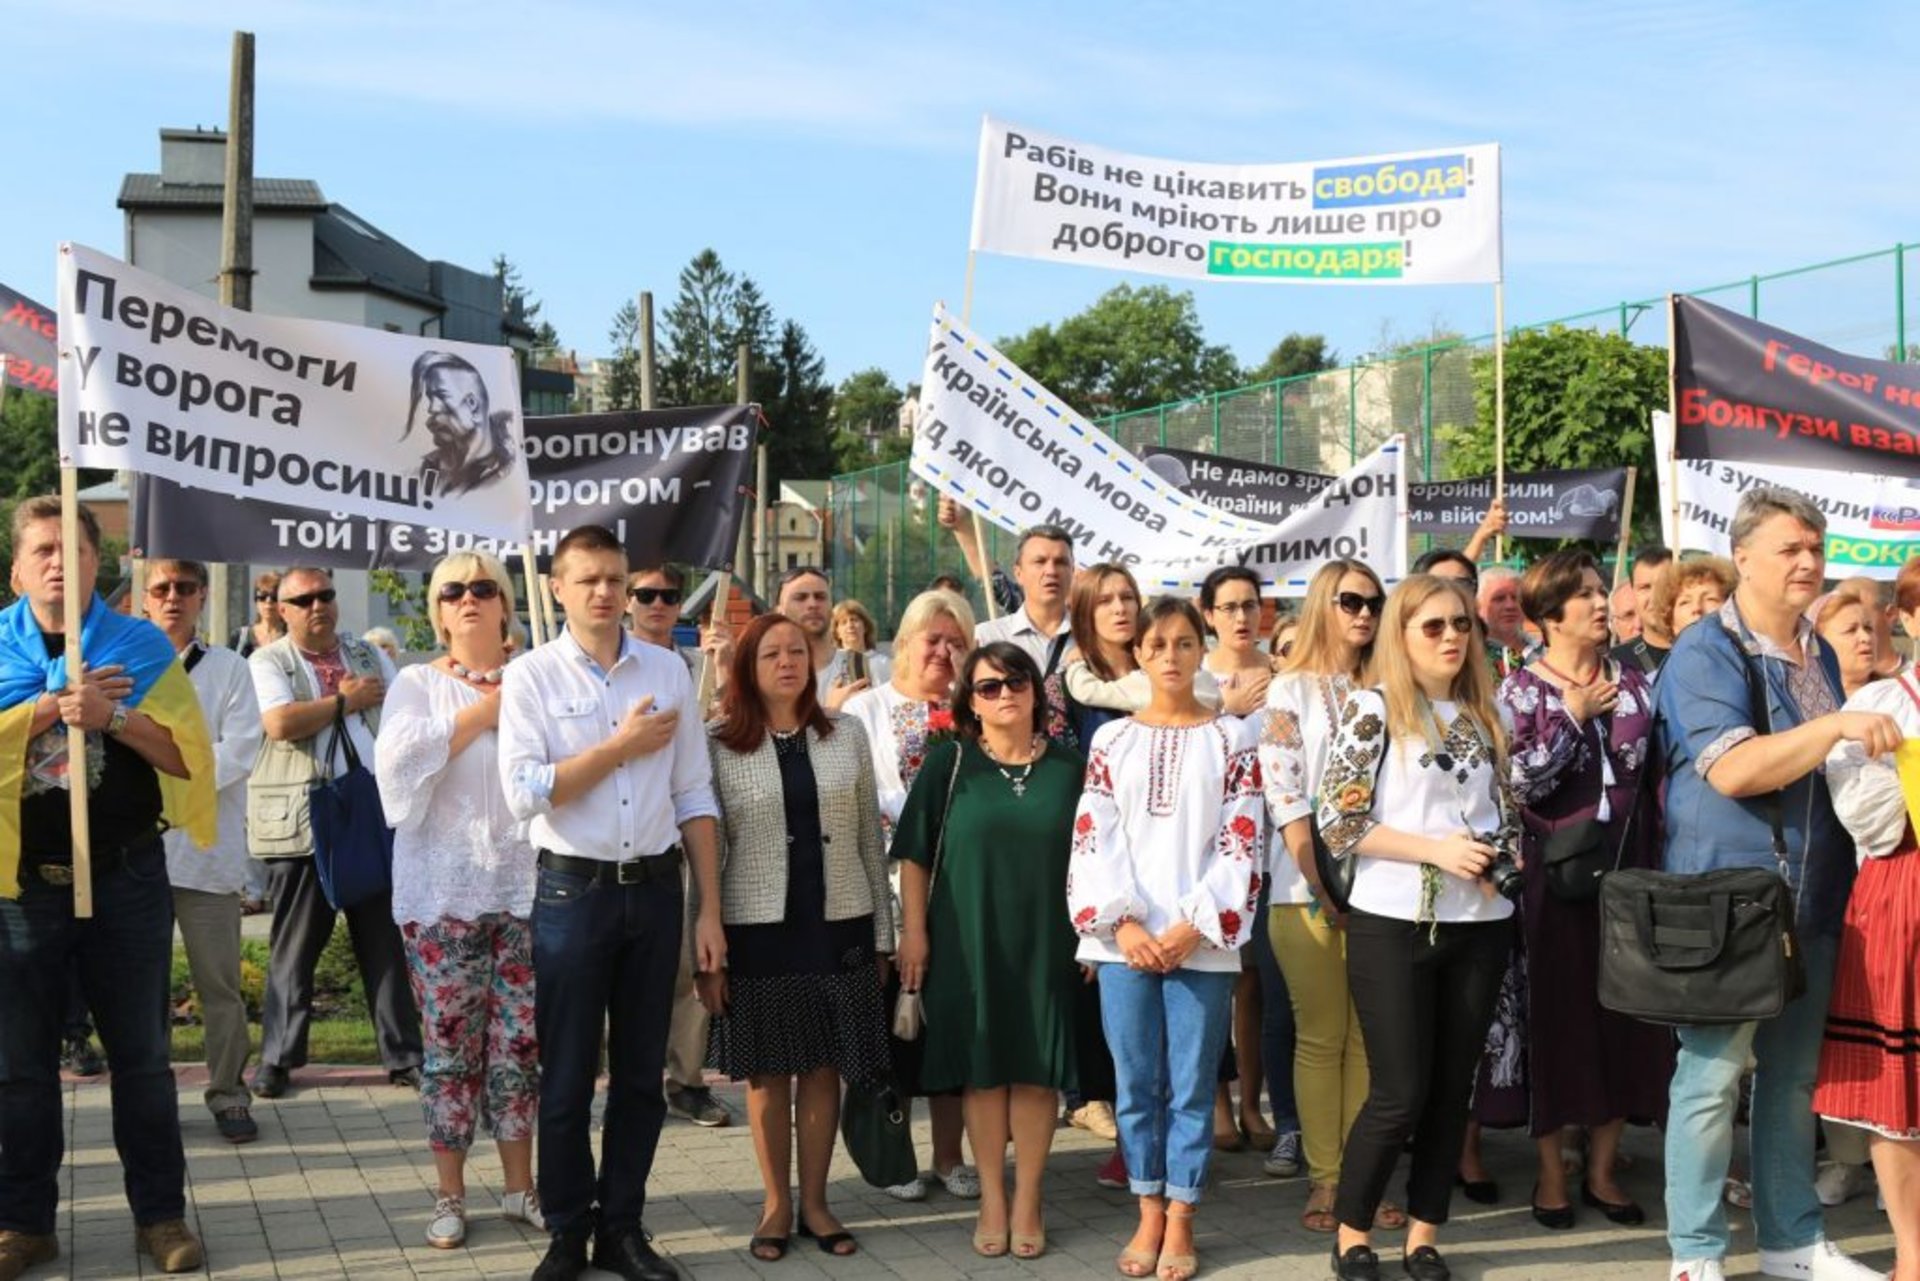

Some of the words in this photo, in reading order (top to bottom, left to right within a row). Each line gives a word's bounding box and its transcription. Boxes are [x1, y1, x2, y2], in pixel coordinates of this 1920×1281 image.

[1004, 132, 1094, 176] Рабів
[1104, 164, 1143, 188] не
[1153, 170, 1306, 201] цікавить
[1315, 157, 1476, 200] свобода!
[1034, 172, 1122, 212] Вони
[1132, 200, 1257, 235] мріють
[1267, 210, 1366, 235] лише
[1376, 205, 1442, 237] про
[1052, 222, 1205, 263] доброго
[1214, 239, 1414, 276] господаря!
[75, 268, 357, 391] Перемоги
[116, 353, 303, 427] ворога
[1763, 339, 1879, 394] Герої
[932, 341, 1083, 478] країнська
[1084, 472, 1168, 533] мова
[1324, 474, 1398, 508] дон
[1682, 390, 1840, 441] Боягузи
[1849, 423, 1920, 454] вза
[78, 410, 130, 446] не
[146, 421, 439, 511] випросиш!
[1191, 460, 1223, 481] Не
[1227, 469, 1289, 488] дамо
[1295, 473, 1333, 492] зро
[529, 477, 682, 514] орогом
[948, 439, 1042, 516] якого
[1045, 507, 1096, 546] ми
[1098, 541, 1142, 566] не
[271, 510, 351, 550] той
[367, 517, 376, 550] і
[389, 524, 413, 552] є
